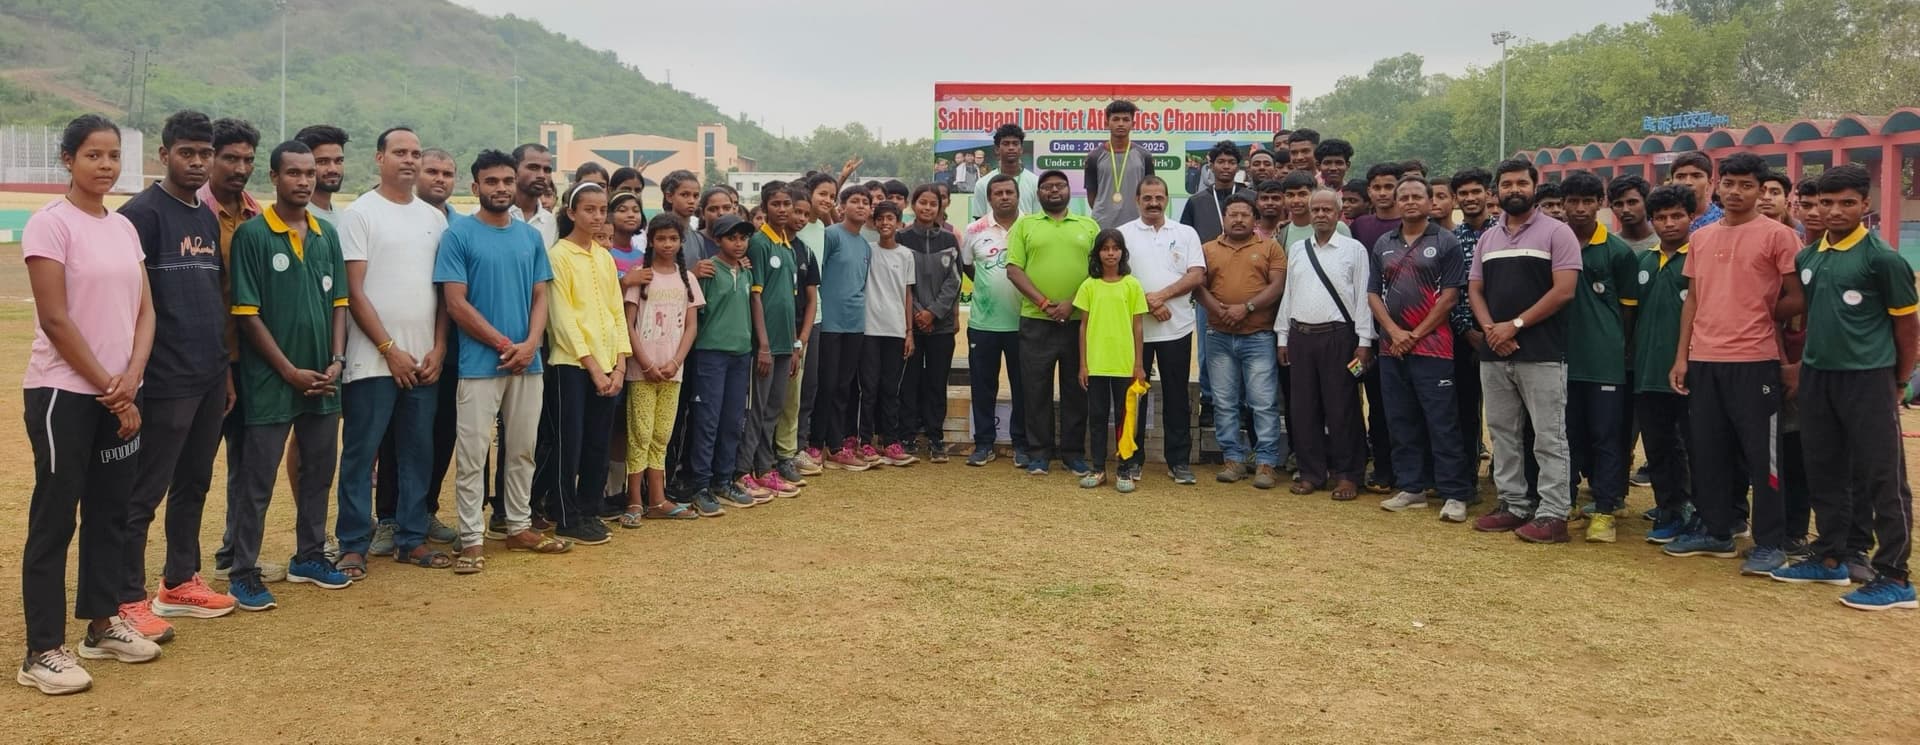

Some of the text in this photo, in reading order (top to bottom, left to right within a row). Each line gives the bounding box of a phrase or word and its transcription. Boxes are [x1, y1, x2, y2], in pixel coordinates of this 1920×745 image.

[1024, 108, 1083, 131] District
[1087, 108, 1159, 132] Atics
[1164, 108, 1283, 133] Championship
[1053, 142, 1075, 151] Date
[1045, 158, 1071, 167] Under
